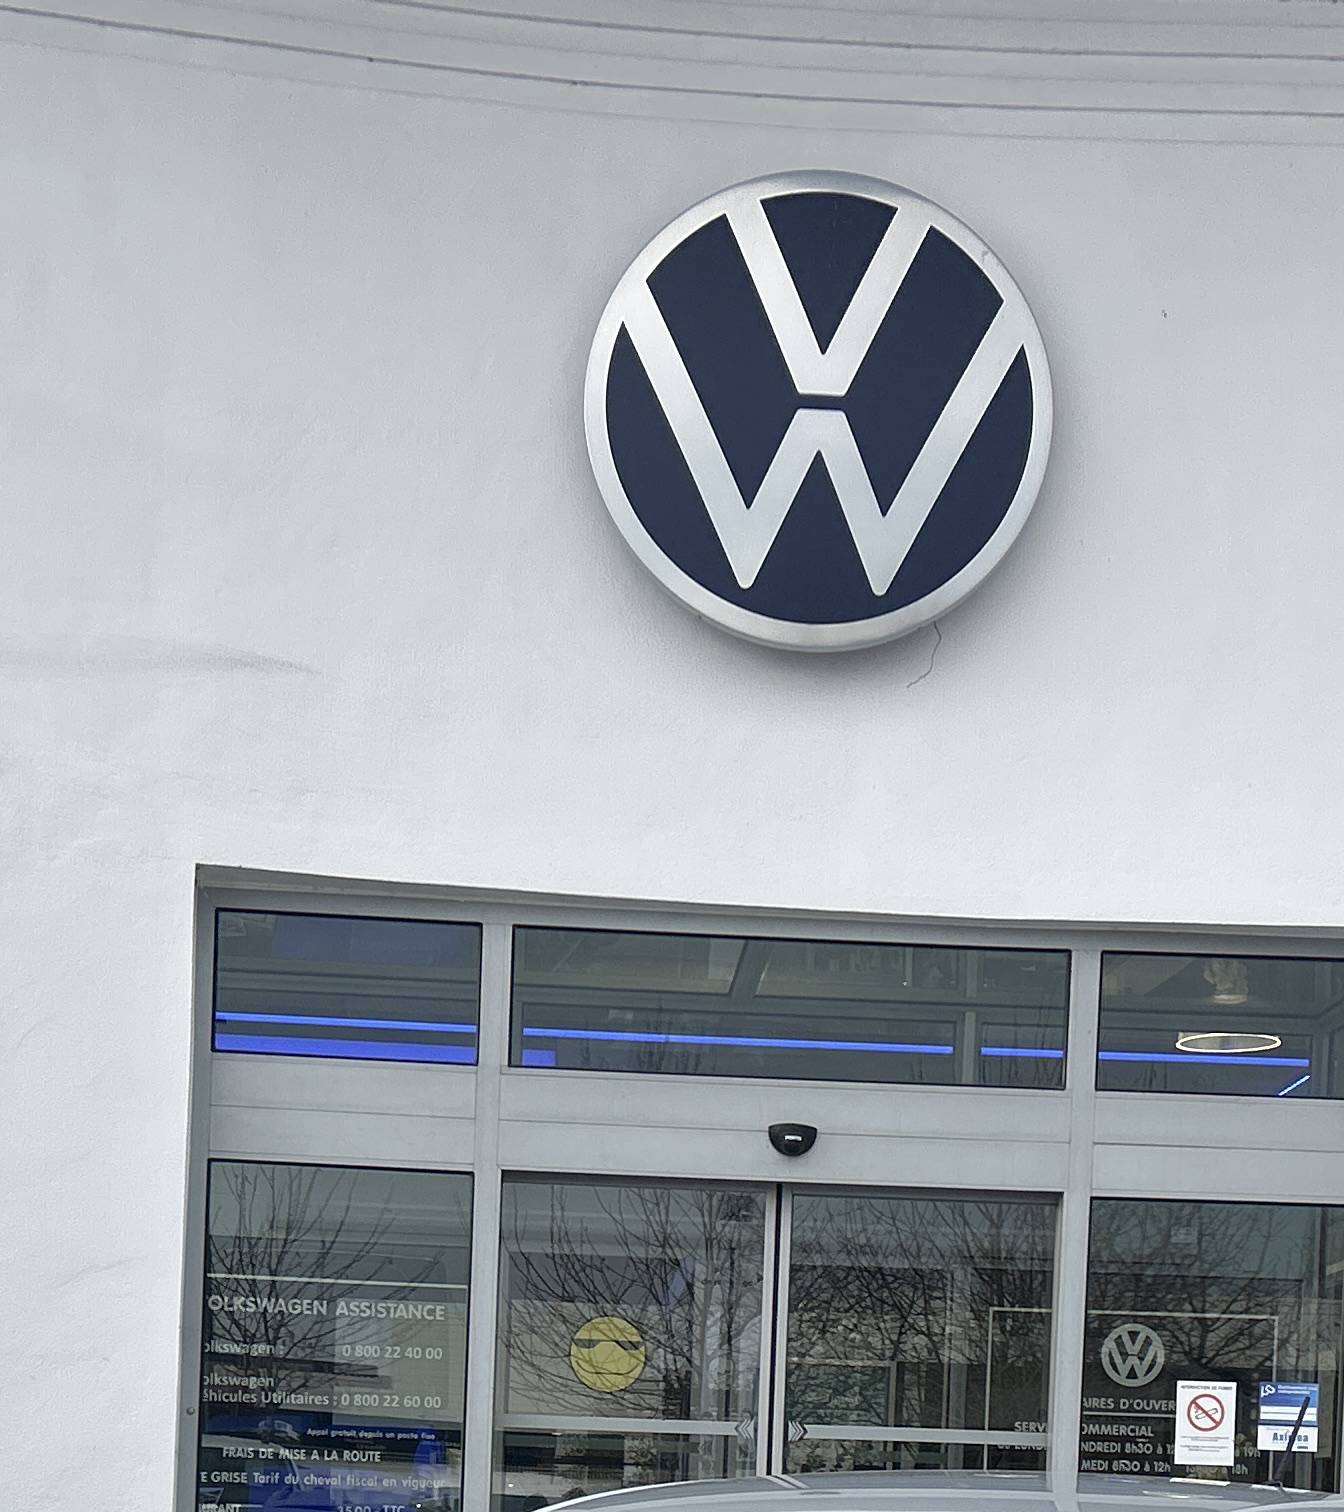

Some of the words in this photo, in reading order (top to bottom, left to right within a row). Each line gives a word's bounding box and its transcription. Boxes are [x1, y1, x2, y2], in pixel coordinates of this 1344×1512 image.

[336, 1301, 445, 1321] ASSISTANCE
[356, 1346, 380, 1357] 800
[385, 1347, 400, 1358] 22
[405, 1347, 422, 1359] 40
[425, 1348, 442, 1359] 00
[262, 1391, 329, 1405] Utilitaires
[355, 1394, 379, 1406] 800
[383, 1395, 399, 1407] 22
[403, 1395, 421, 1408] 60
[424, 1396, 441, 1408] 00
[222, 1447, 254, 1459] FRAIS
[259, 1448, 273, 1459] DE
[279, 1449, 306, 1460] MISE
[311, 1450, 320, 1461] A
[324, 1450, 339, 1461] LA
[343, 1451, 381, 1462] ROUTE
[210, 1471, 247, 1483] GRISE
[253, 1472, 280, 1485] Tarif
[284, 1473, 299, 1485] du
[304, 1473, 341, 1486] cheval
[346, 1474, 377, 1487] fiscal
[382, 1477, 397, 1486] en
